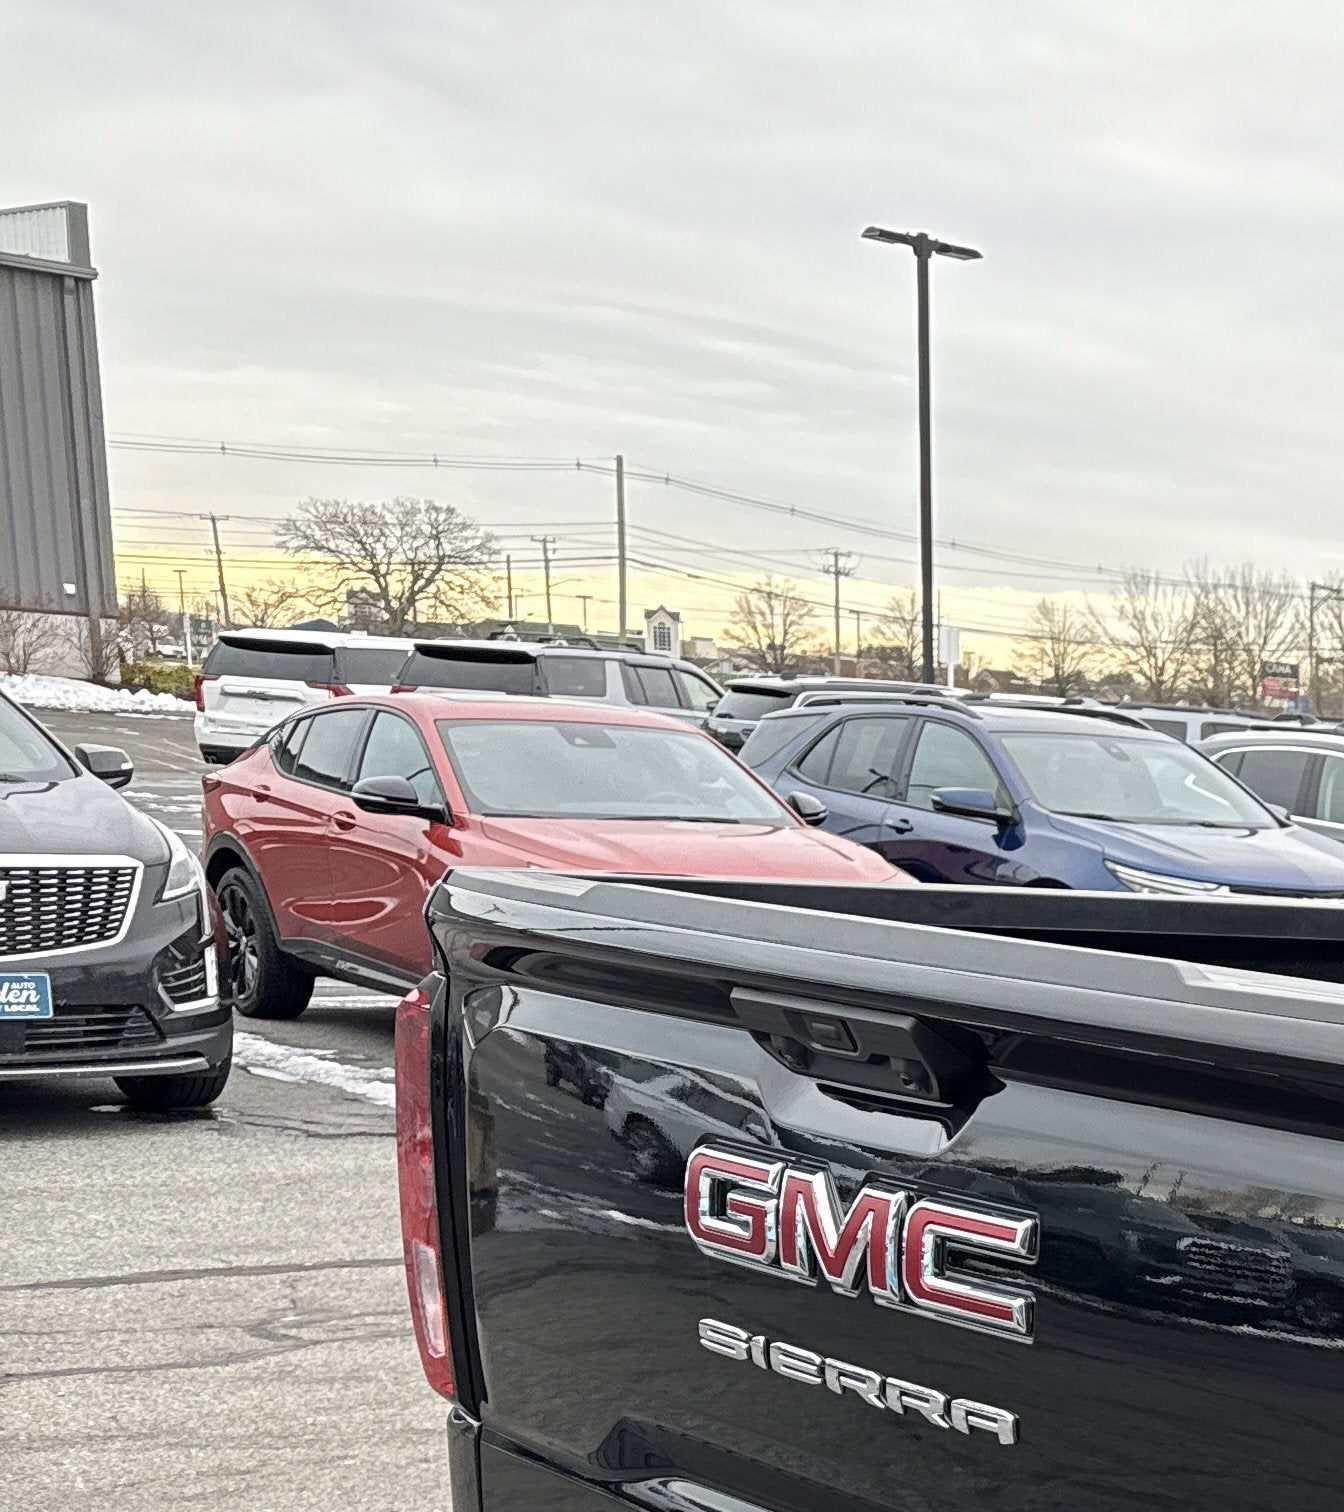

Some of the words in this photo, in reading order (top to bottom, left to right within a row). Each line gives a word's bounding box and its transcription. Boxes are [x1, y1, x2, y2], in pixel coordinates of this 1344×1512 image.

[10, 981, 36, 990] AUTO
[684, 1137, 1041, 1345] GMC
[699, 1317, 1020, 1445] SIERRA
